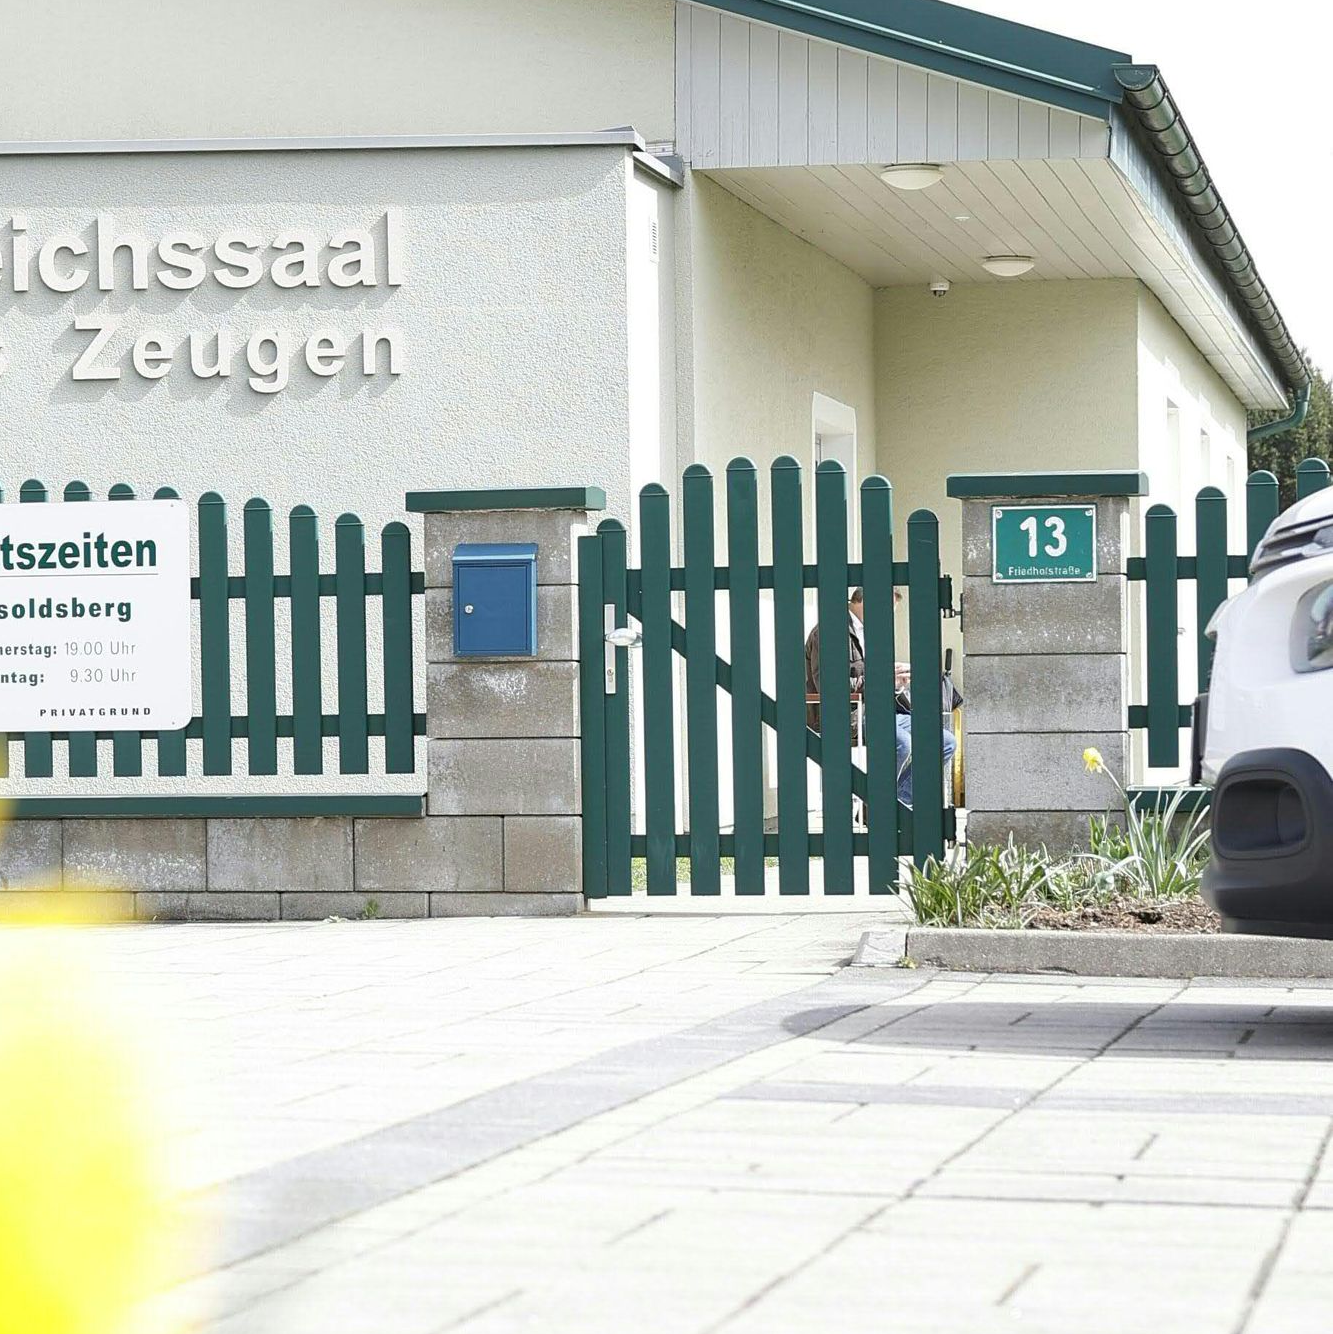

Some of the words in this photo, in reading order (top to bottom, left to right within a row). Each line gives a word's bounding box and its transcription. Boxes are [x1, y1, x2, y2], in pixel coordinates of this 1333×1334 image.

[72, 319, 403, 394] Zeugen
[1019, 516, 1067, 557] 13
[1008, 566, 1081, 577] Friedhofstraße
[64, 641, 103, 656] 19.00
[110, 640, 136, 656] Uhr
[70, 668, 103, 683] 9.30
[110, 668, 136, 683] Uhr
[39, 707, 151, 717] PRIVATGRUND
